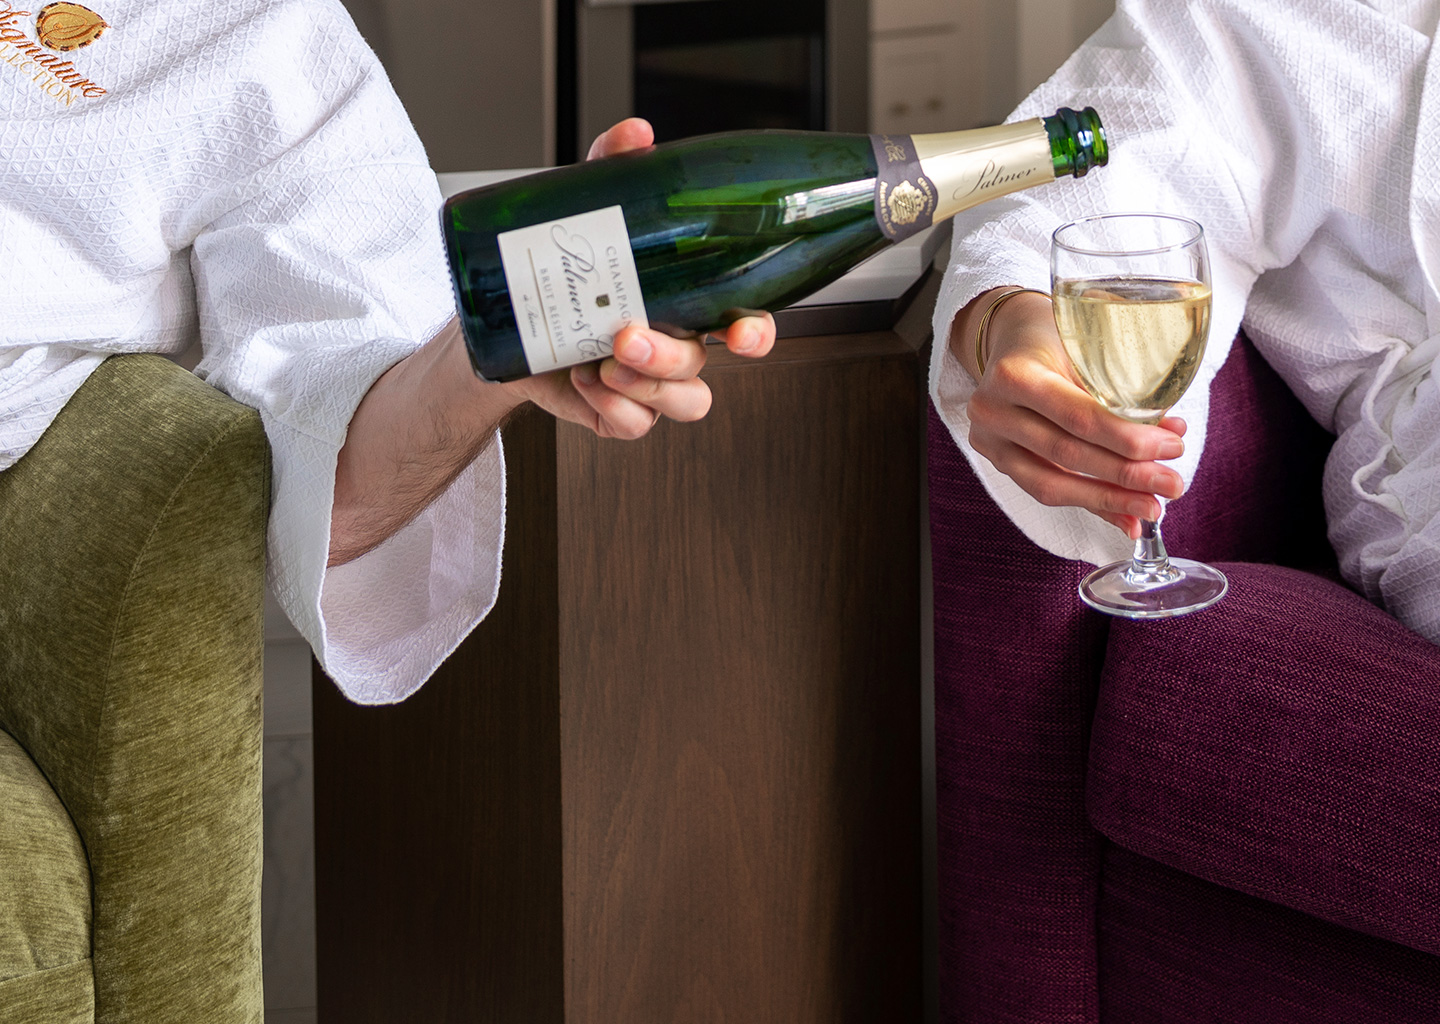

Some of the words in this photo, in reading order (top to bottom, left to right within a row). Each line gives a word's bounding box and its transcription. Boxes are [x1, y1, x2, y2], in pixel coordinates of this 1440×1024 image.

[952, 159, 1037, 201] Palmer
[539, 268, 556, 300] BRUT
[550, 224, 600, 318] Palmer
[605, 245, 633, 328] CHAMPAGN
